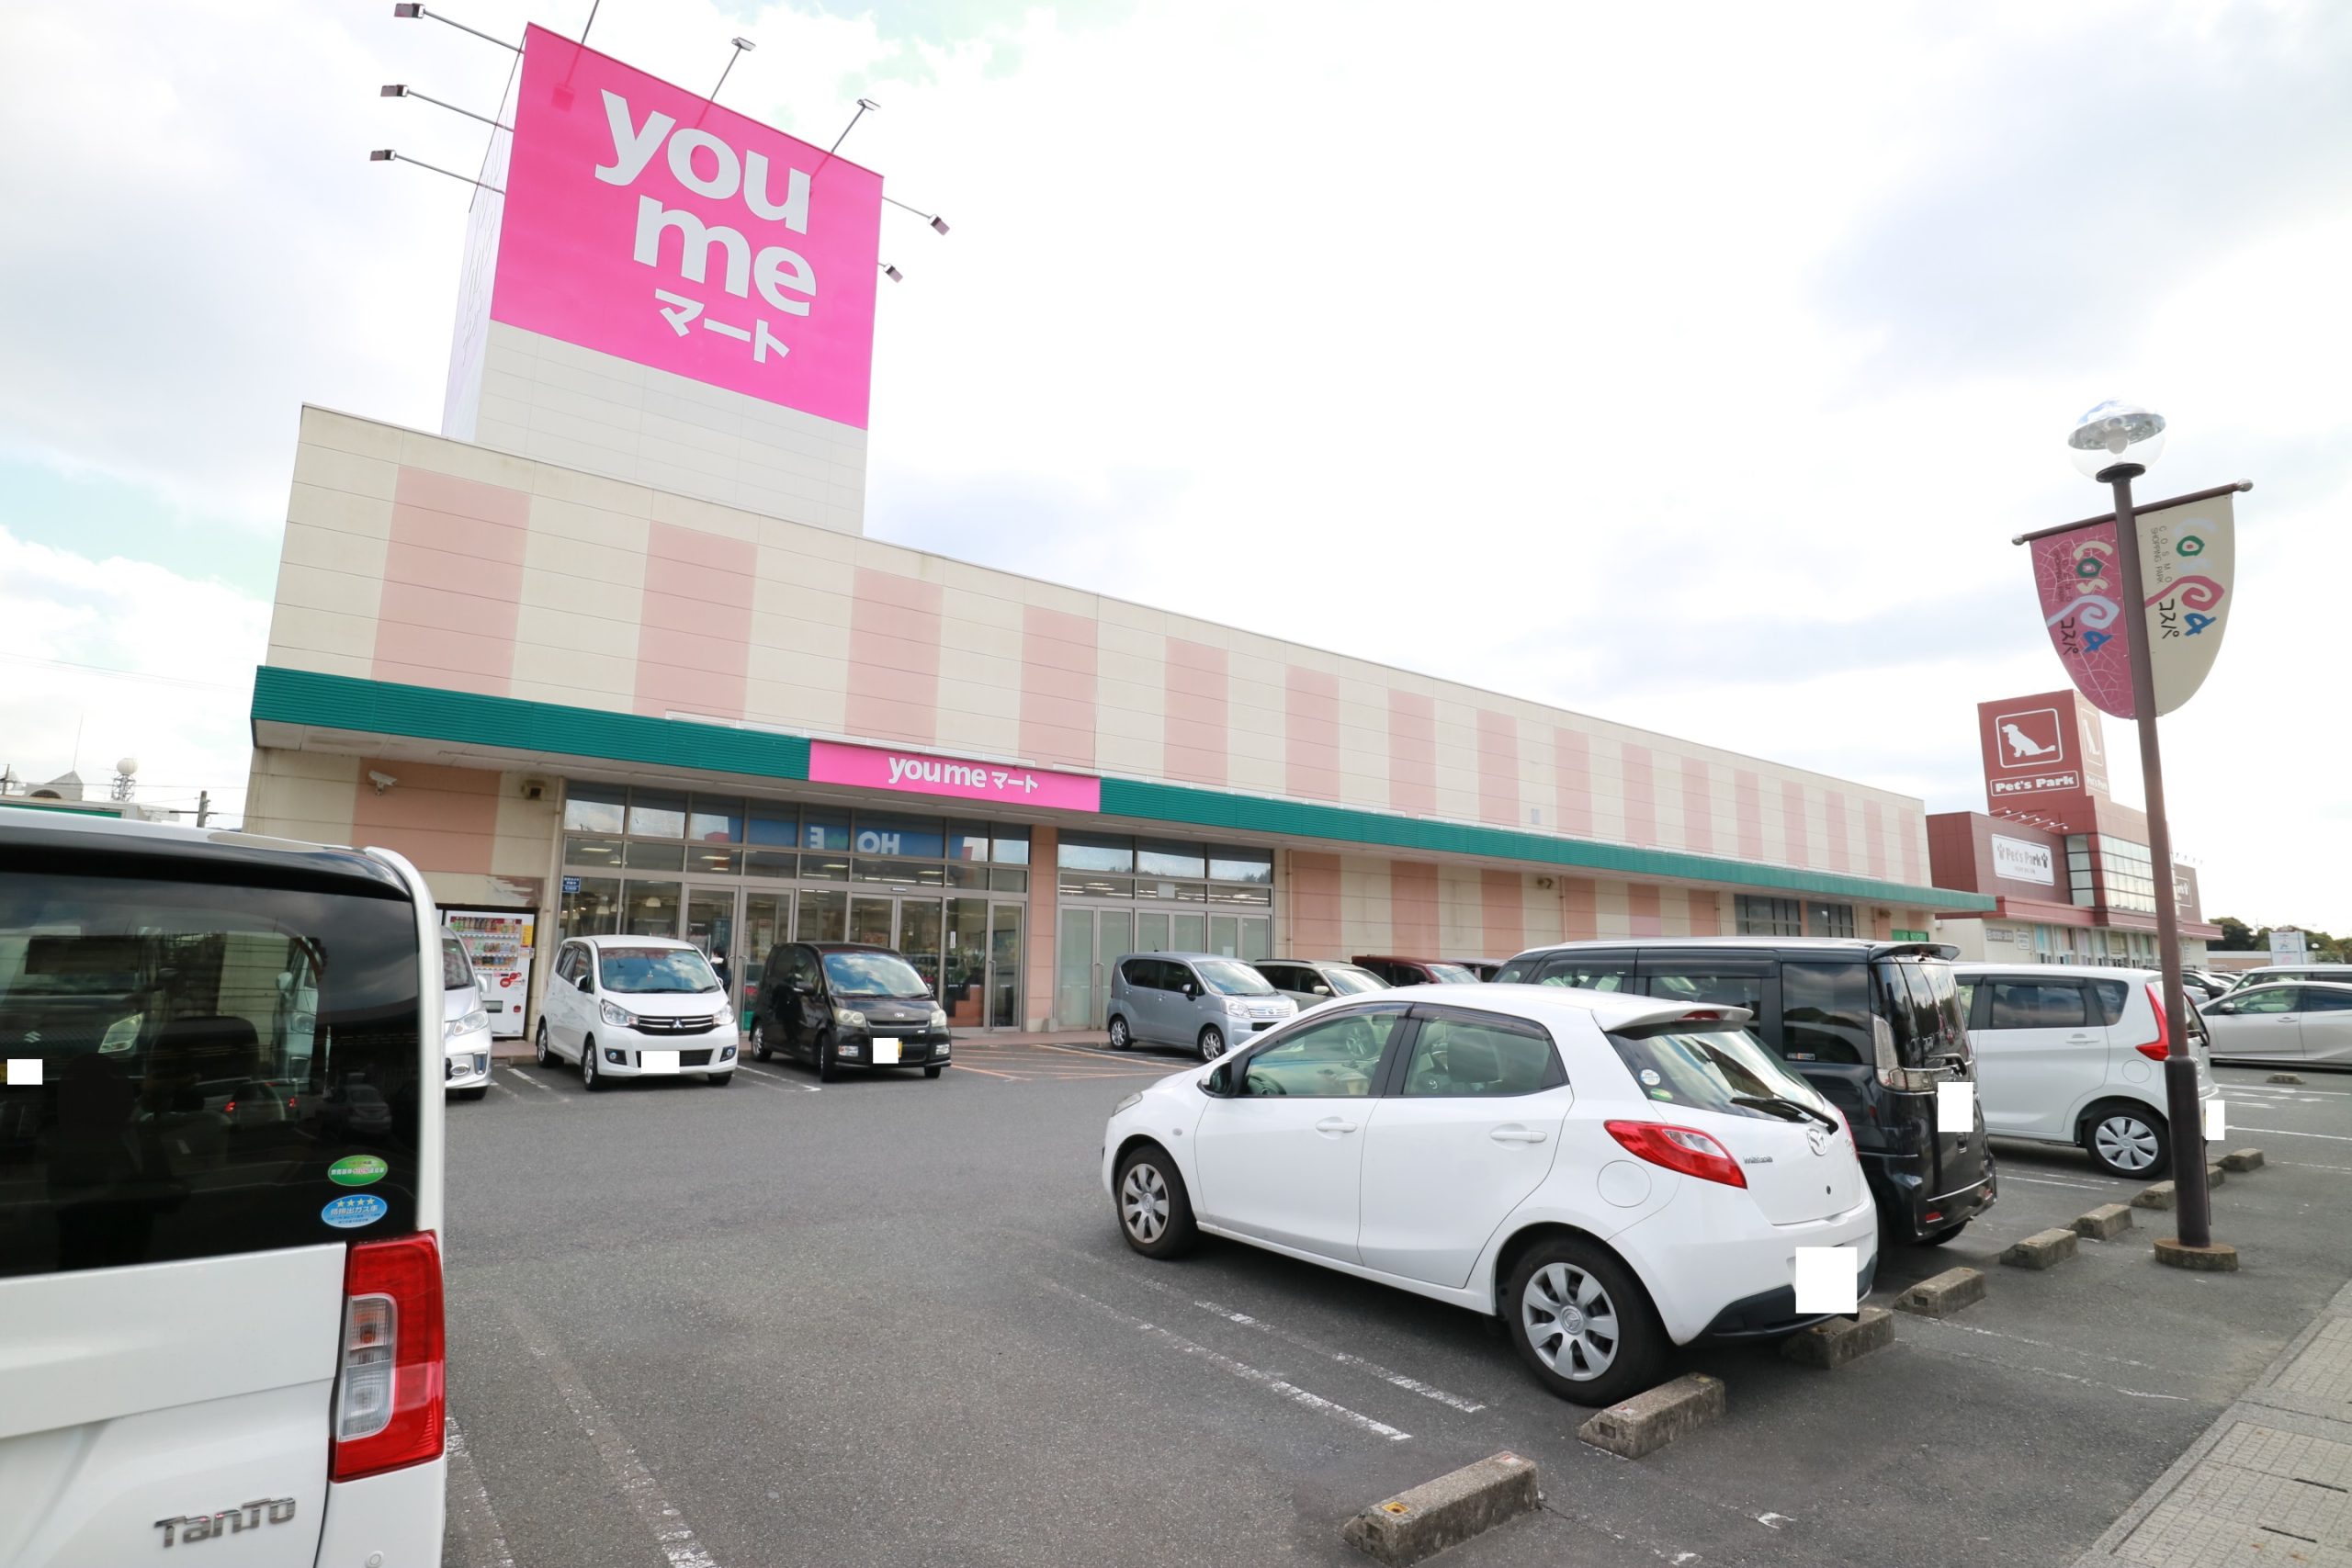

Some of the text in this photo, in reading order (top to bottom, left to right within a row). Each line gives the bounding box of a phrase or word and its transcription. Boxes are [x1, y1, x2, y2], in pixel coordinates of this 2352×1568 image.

[595, 88, 811, 235] you
[633, 195, 817, 317] me
[655, 288, 791, 364] マート
[2061, 617, 2079, 655] コスパ
[2159, 598, 2180, 639] コスパ
[991, 771, 1039, 794] マート
[1995, 775, 2075, 792] Pet's Park
[2024, 851, 2041, 867] Park
